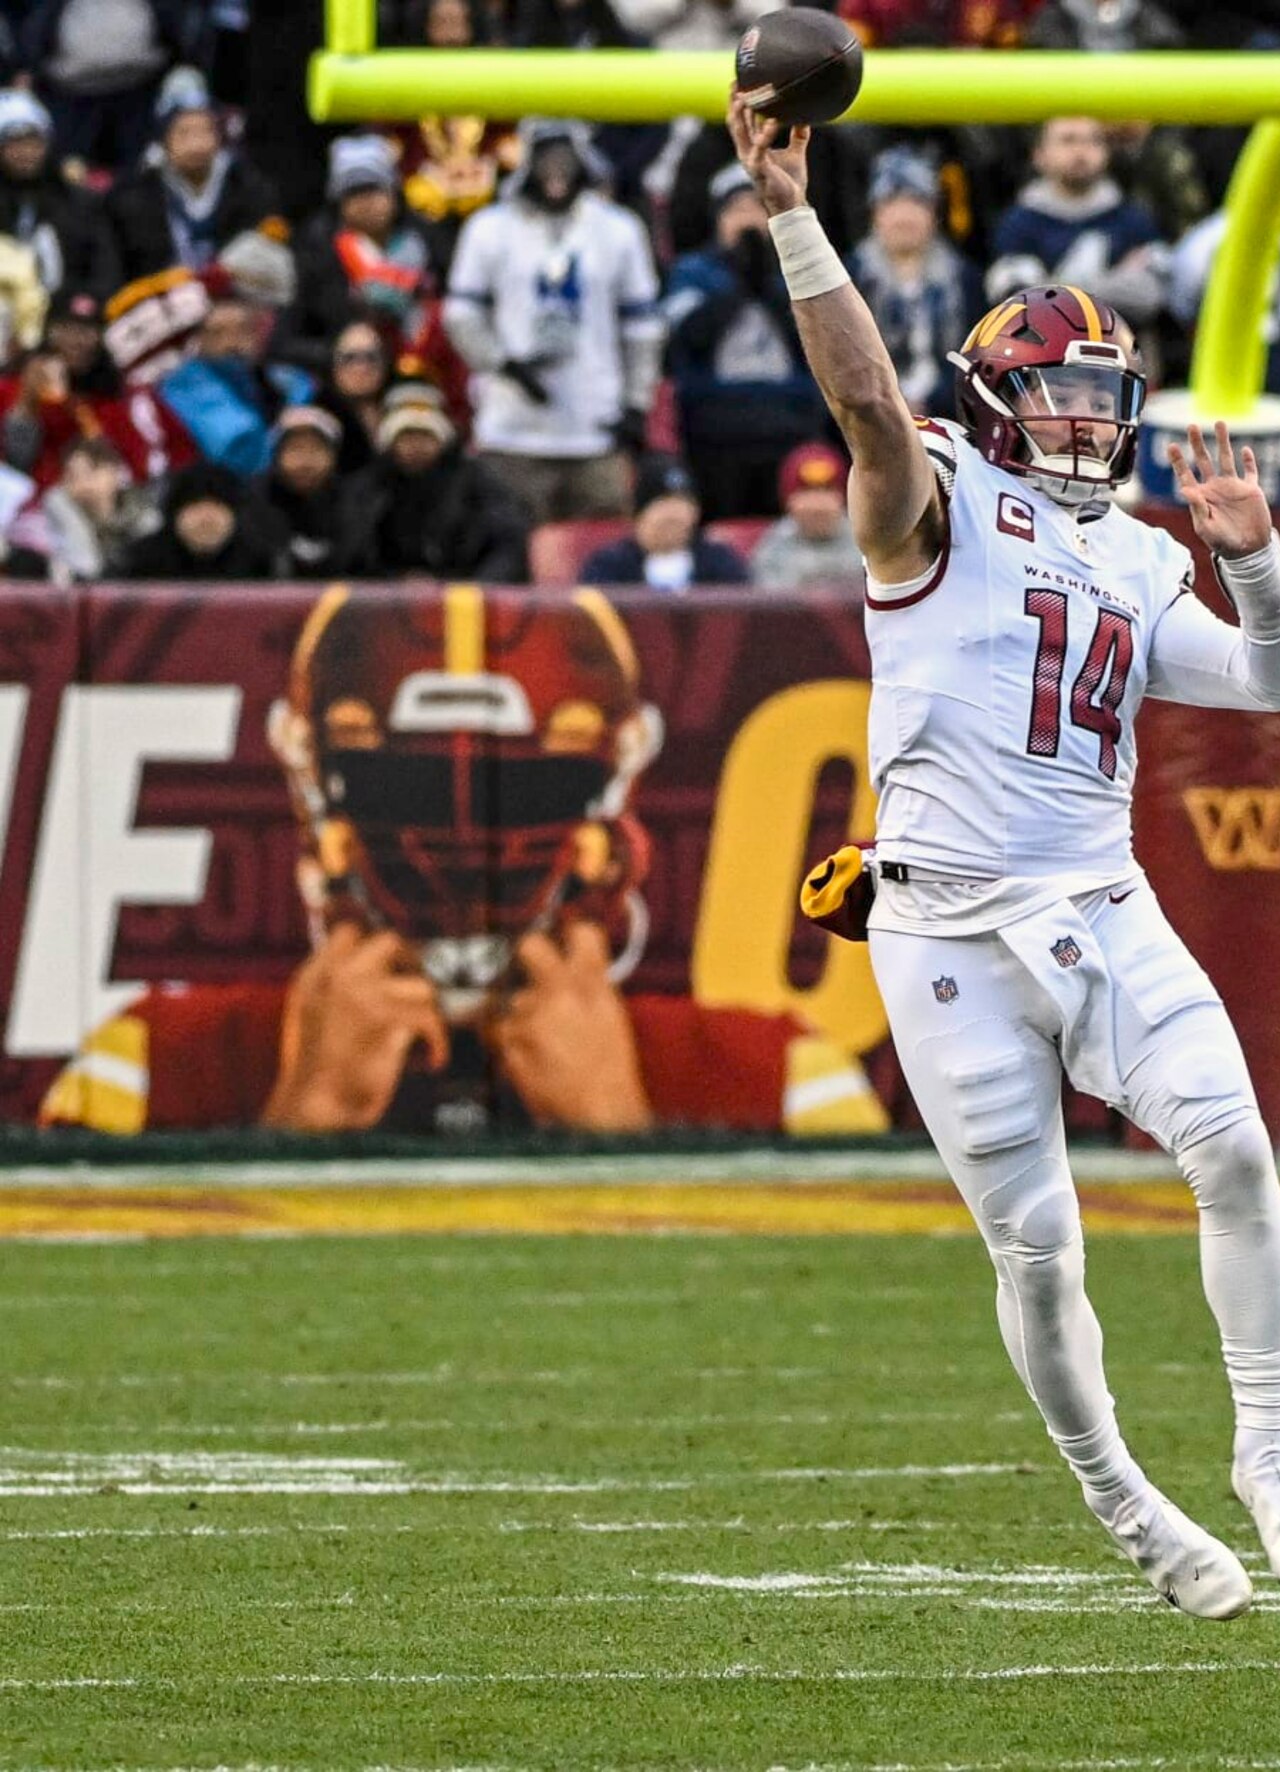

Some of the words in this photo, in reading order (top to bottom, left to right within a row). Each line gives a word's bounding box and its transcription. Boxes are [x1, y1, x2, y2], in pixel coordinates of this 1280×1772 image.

[1000, 496, 1033, 531] C
[1024, 564, 1141, 616] WASHINGTON
[1024, 587, 1134, 781] 14
